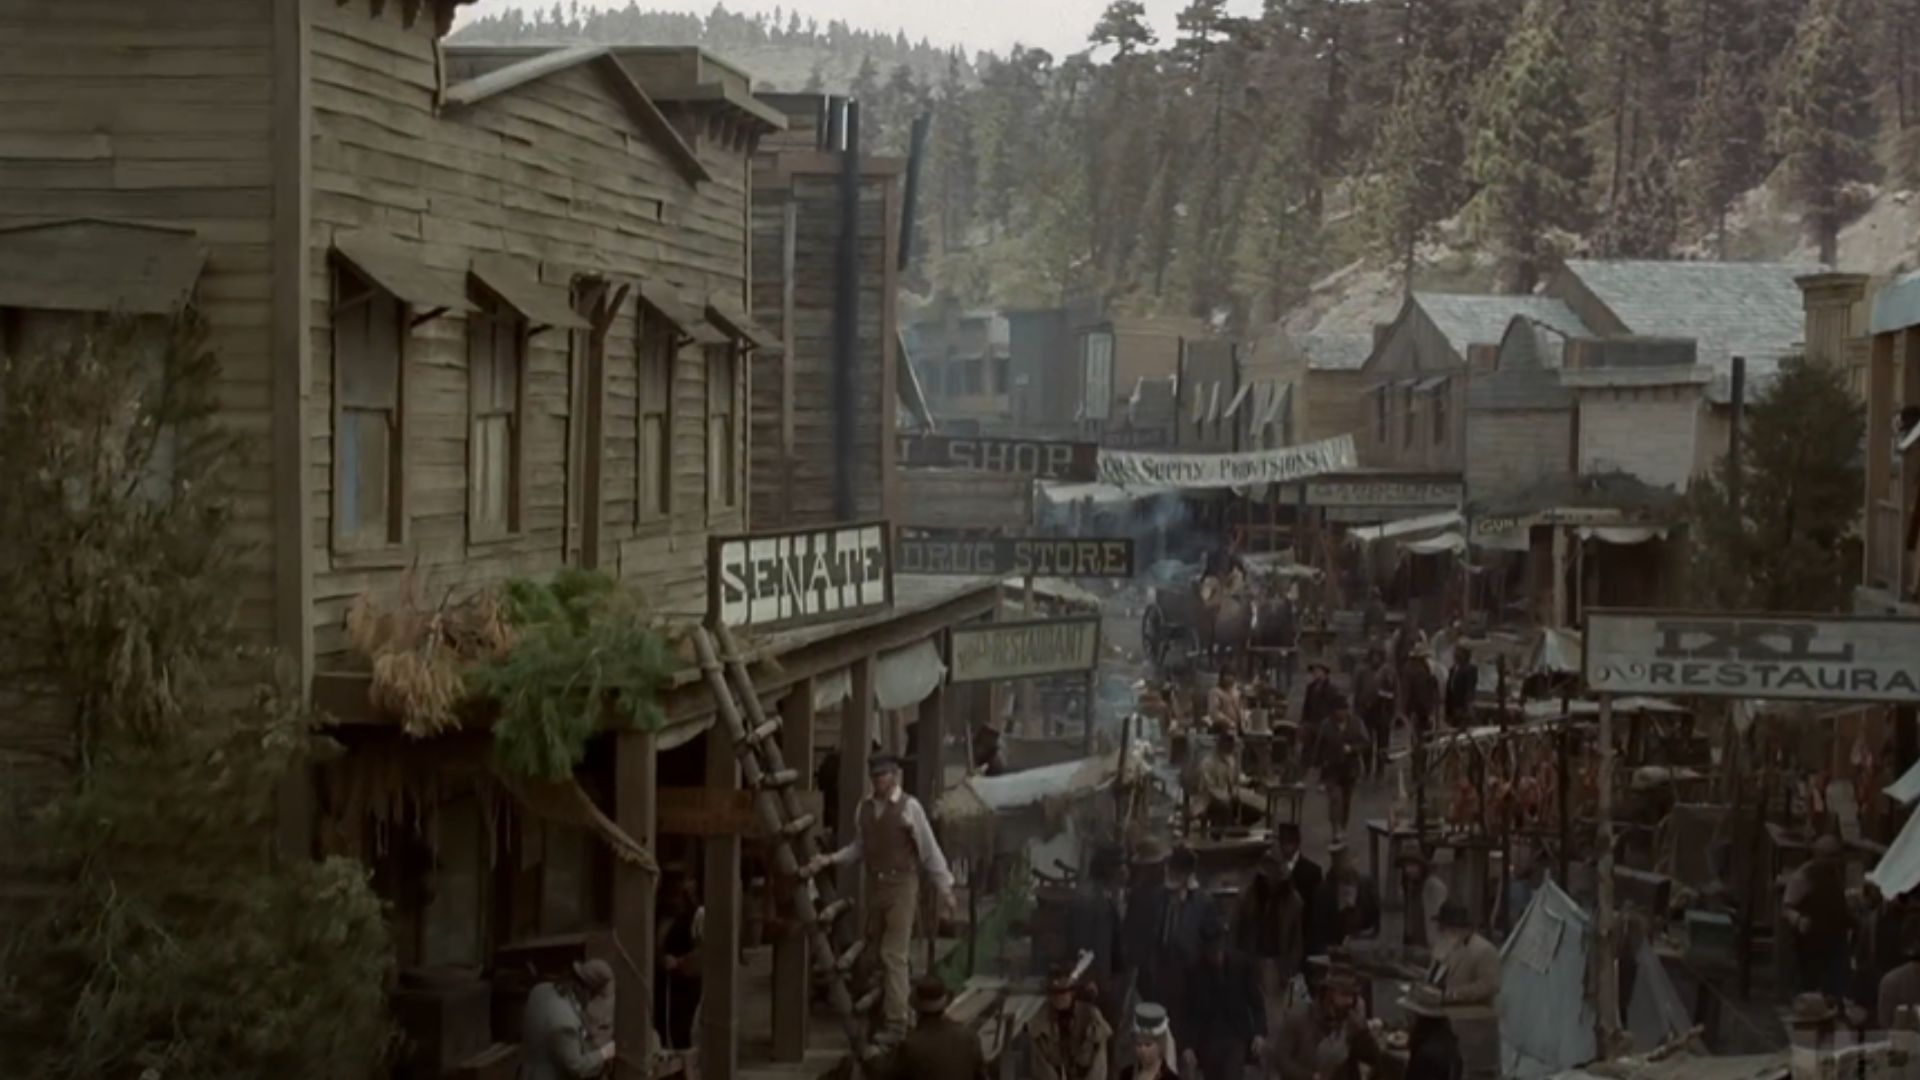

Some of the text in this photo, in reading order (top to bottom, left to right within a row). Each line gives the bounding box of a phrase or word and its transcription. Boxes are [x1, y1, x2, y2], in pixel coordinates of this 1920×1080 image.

[948, 440, 1073, 477] SHOP
[721, 525, 885, 627] SENATE
[902, 541, 1127, 574] DRUG STORE
